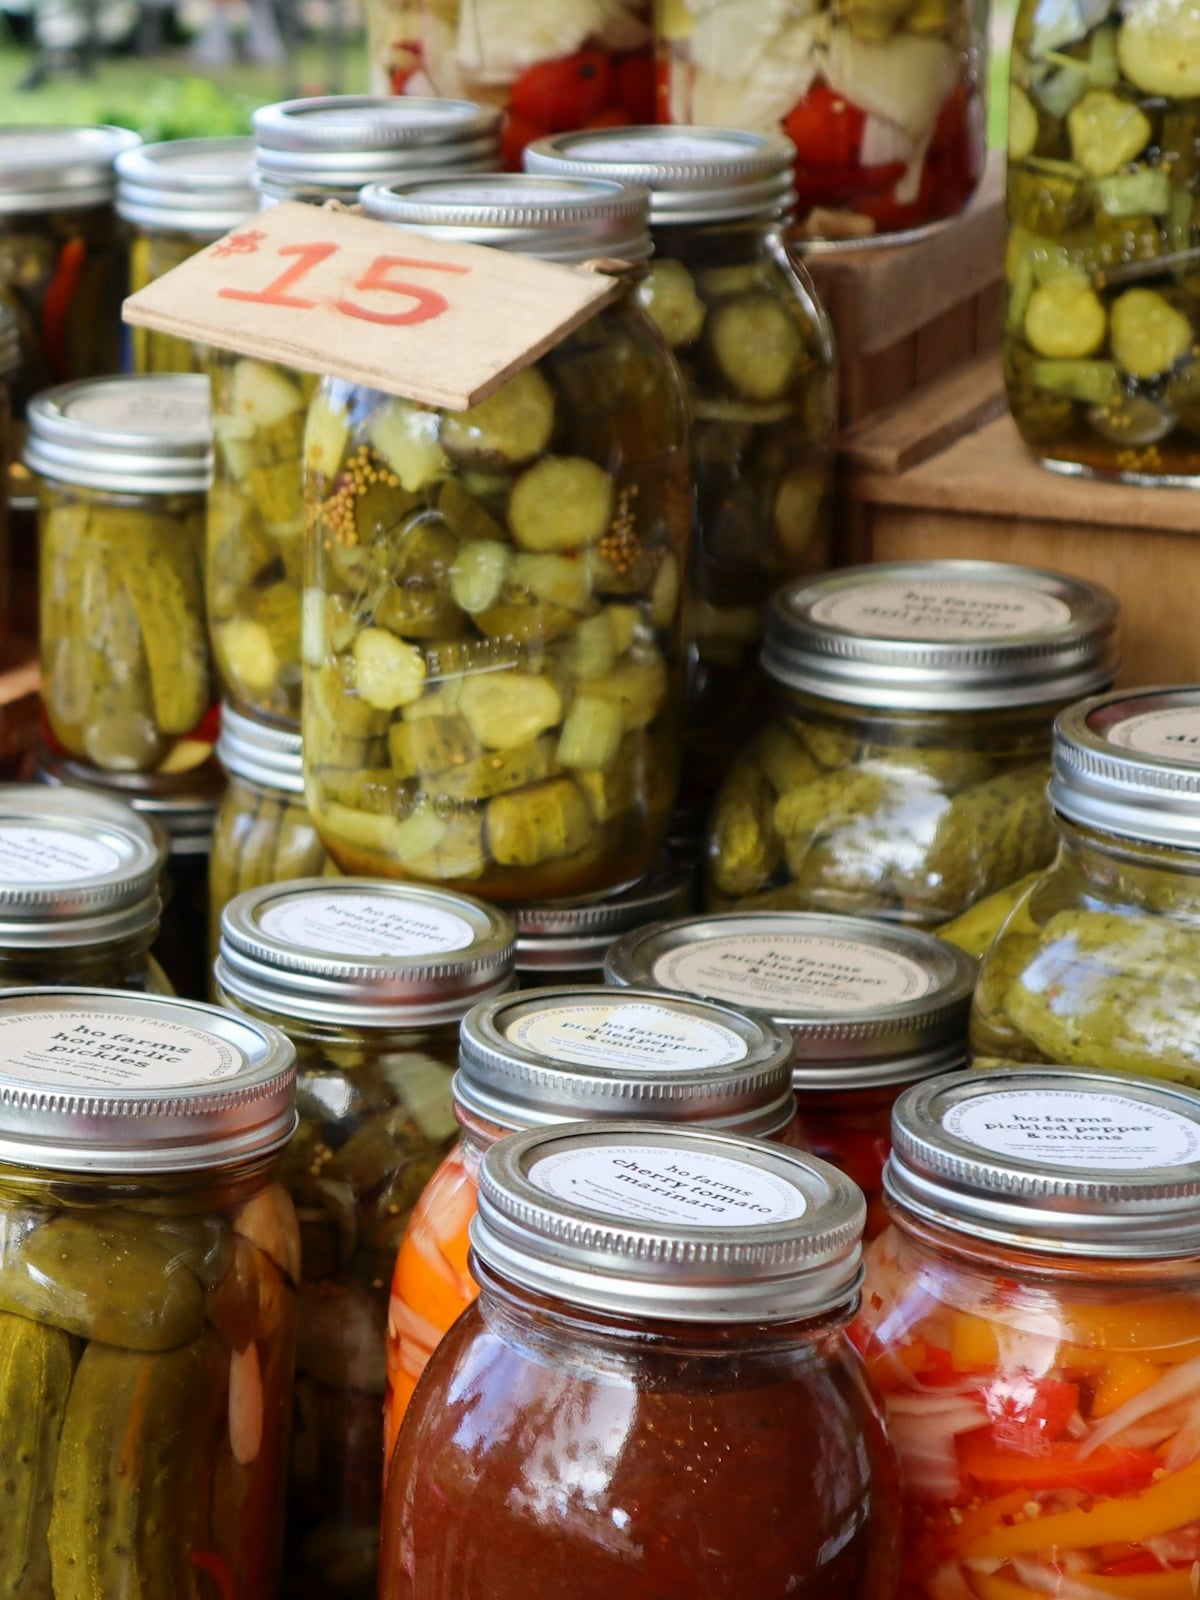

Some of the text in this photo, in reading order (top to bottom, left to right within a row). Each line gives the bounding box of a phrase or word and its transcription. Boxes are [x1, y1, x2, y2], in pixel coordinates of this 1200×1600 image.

[209, 228, 473, 327] $15
[325, 904, 378, 924] bread
[362, 906, 440, 931] ho farms
[720, 953, 889, 985] pickled pepper
[766, 951, 863, 972] ho farms
[748, 966, 839, 987] & onions
[72, 1024, 193, 1054] ho farms
[560, 1022, 636, 1041] pickled
[637, 1037, 709, 1053] pepper
[601, 1021, 687, 1042] ho farms
[46, 1045, 151, 1069] pickles
[50, 1032, 97, 1046] hot
[99, 1040, 183, 1064] garlic
[600, 1038, 666, 1054] onions
[984, 1123, 1154, 1133] pickled pepper
[1011, 1114, 1113, 1123] ho farms
[1046, 1132, 1123, 1141] onions
[611, 1159, 689, 1189] cherry
[690, 1187, 773, 1213] tomato
[614, 1173, 727, 1213] marinara
[664, 1165, 753, 1197] ho farms
